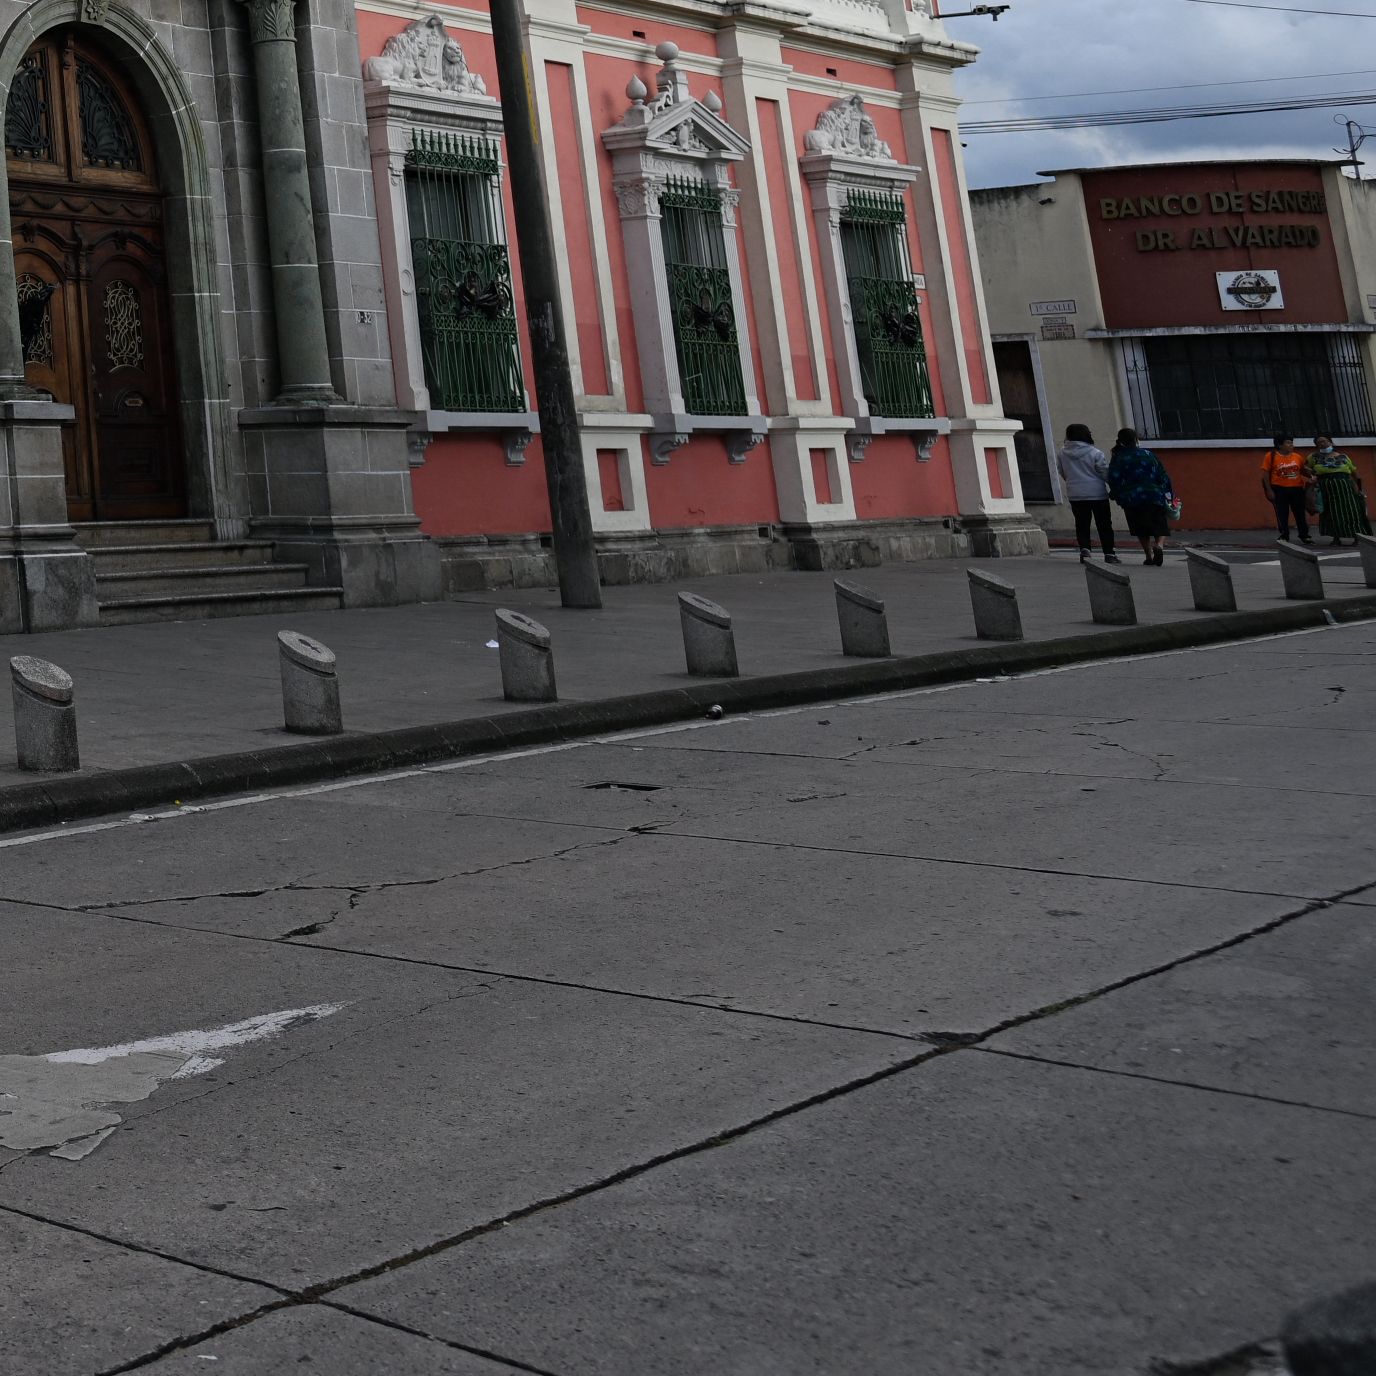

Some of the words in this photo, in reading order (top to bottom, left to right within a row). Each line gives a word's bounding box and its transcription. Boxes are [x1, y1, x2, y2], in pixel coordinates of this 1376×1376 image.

[1099, 193, 1202, 220] BANCO
[1207, 191, 1246, 214] DE
[1249, 190, 1327, 215] SANGRE
[1135, 228, 1184, 252] DR.
[1190, 225, 1321, 249] ALVARADO
[1046, 303, 1073, 312] CALLE
